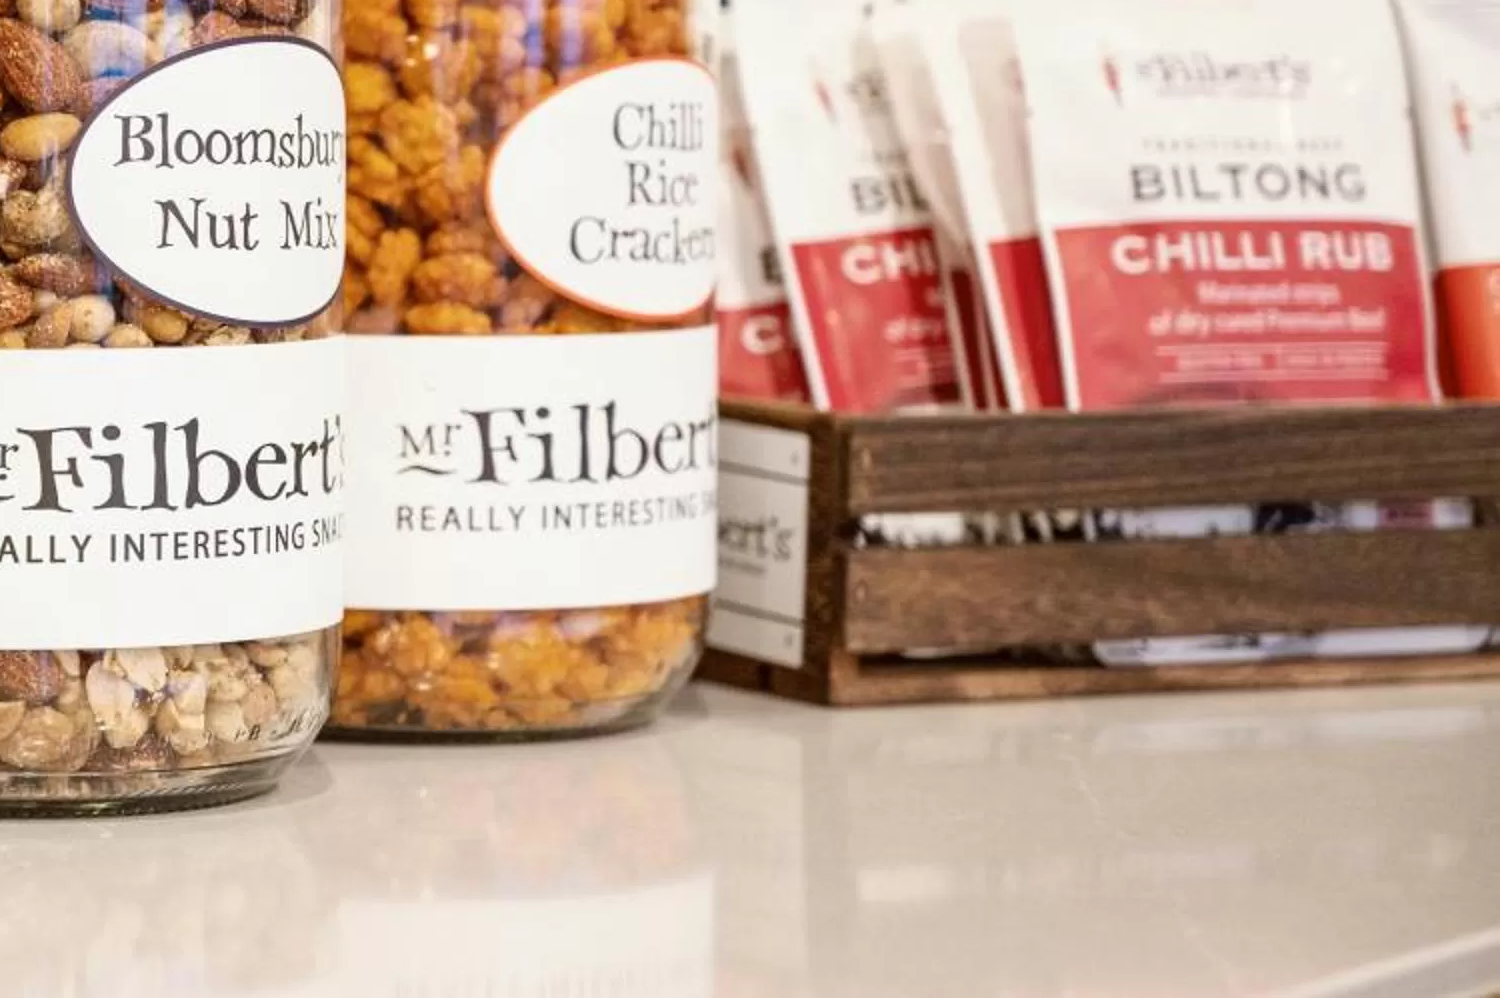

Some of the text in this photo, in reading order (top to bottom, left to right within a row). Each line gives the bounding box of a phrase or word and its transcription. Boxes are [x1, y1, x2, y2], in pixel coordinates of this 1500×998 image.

[613, 102, 703, 151] Chilli
[625, 158, 699, 206] Rice
[1130, 162, 1366, 202] BILTONG
[154, 197, 338, 251] Nut Mix
[1111, 230, 1395, 276] CHILLI RUB
[16, 413, 346, 514] Filbert'
[396, 423, 460, 459] Mr
[395, 504, 527, 533] REALLY
[542, 493, 697, 531] INTERESTING
[110, 520, 306, 561] INTERESTING
